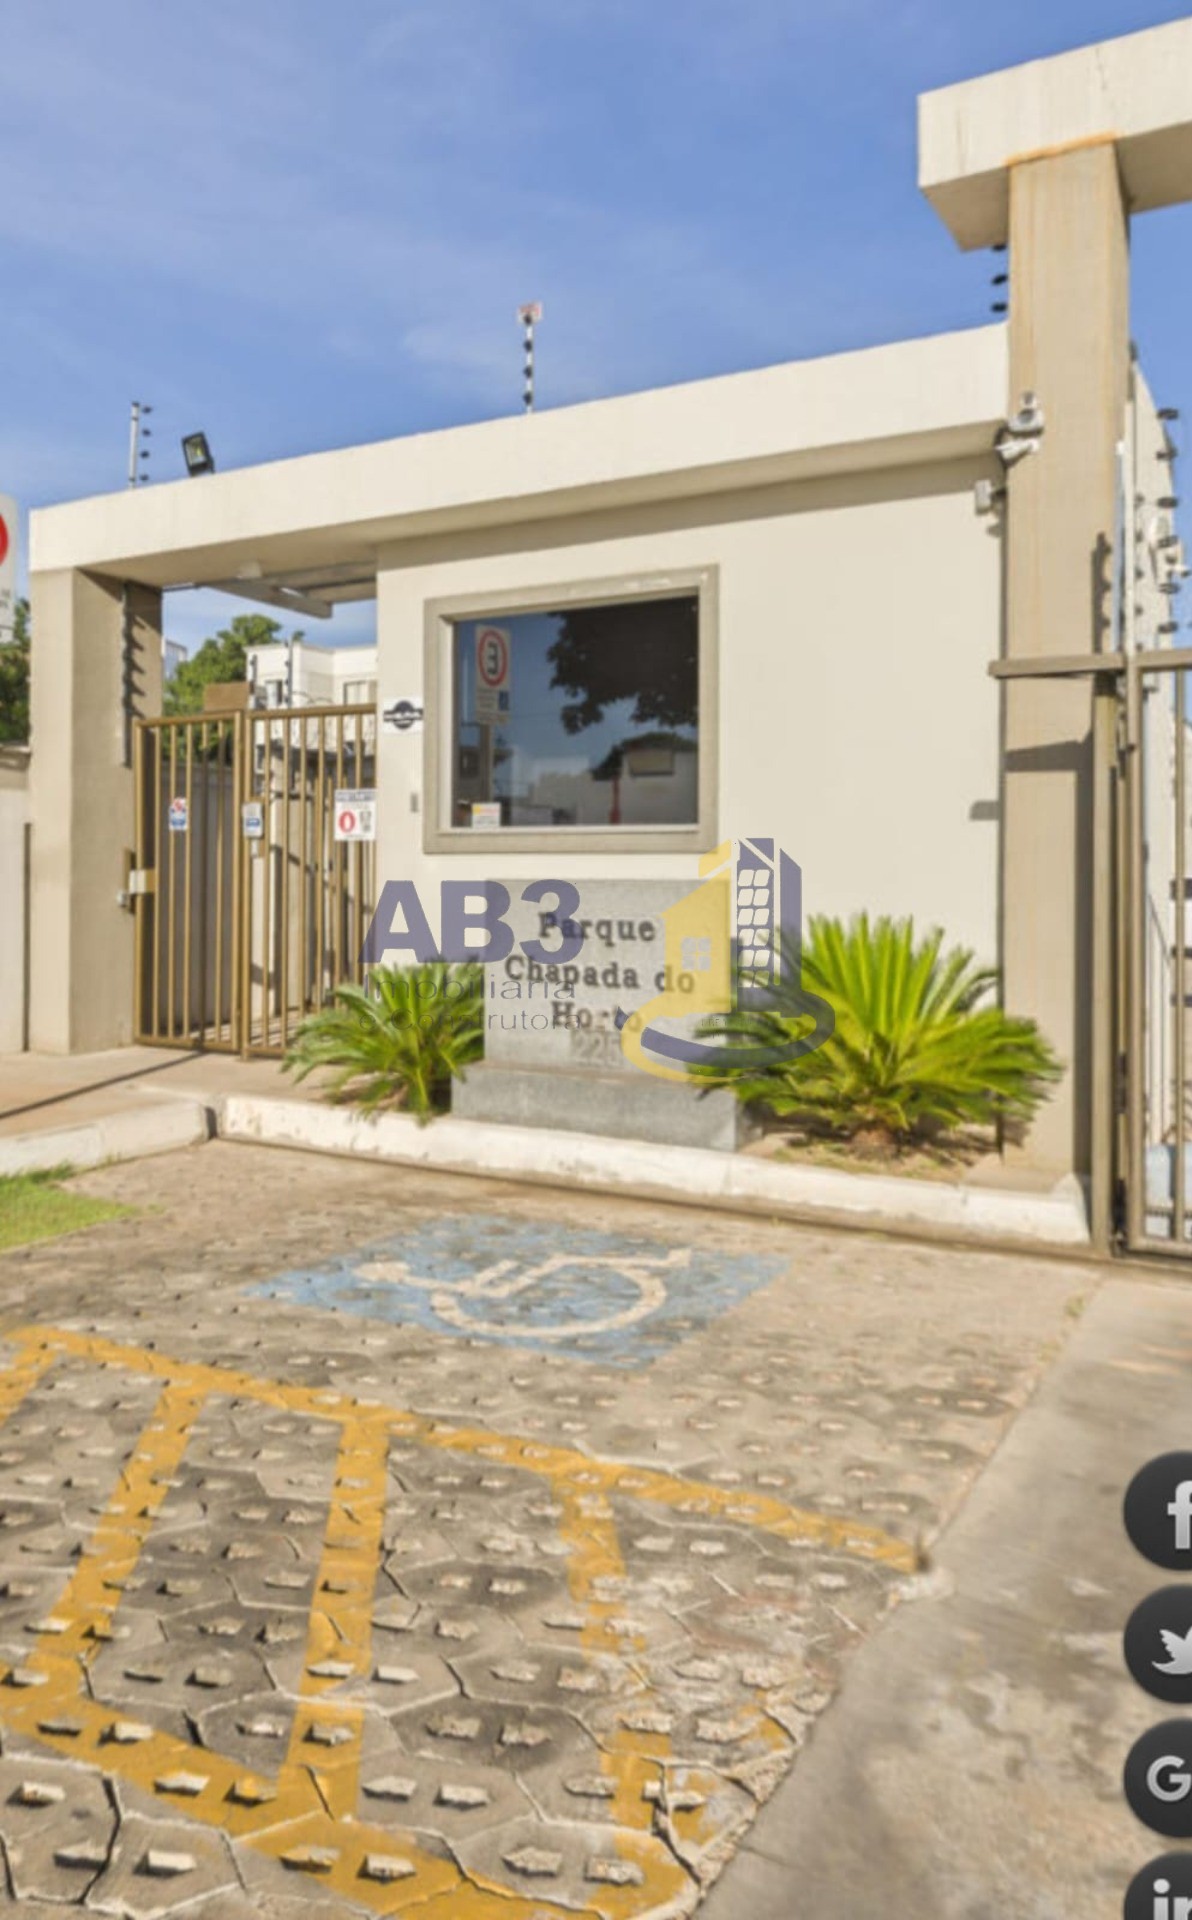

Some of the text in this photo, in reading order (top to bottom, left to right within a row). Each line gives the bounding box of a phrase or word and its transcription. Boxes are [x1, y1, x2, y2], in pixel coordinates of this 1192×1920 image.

[538, 911, 656, 947] Parque
[505, 954, 695, 994] Chapada do
